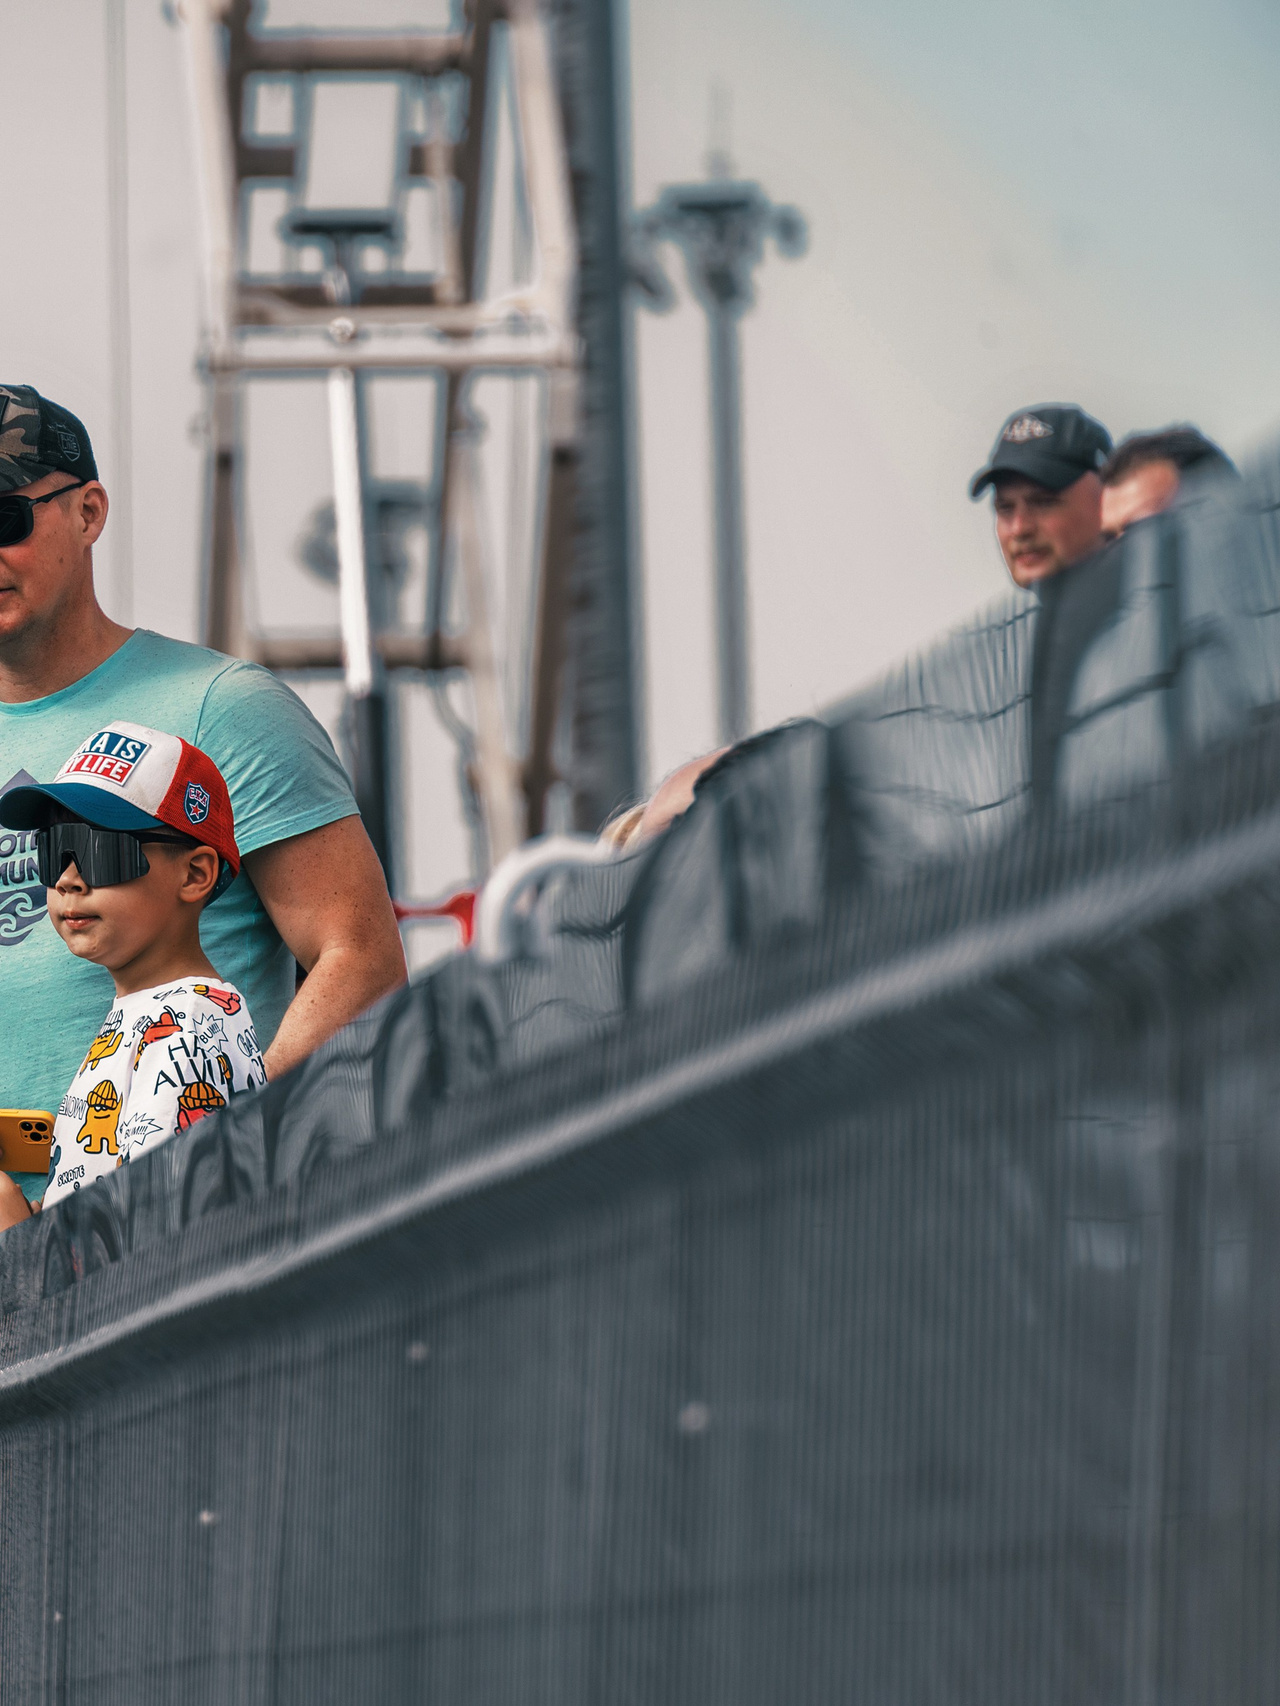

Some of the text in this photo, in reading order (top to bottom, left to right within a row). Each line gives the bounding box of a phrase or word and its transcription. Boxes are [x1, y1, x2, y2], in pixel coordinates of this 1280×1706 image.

[79, 732, 142, 760] KA IS
[80, 754, 129, 781] LIFE
[57, 1164, 86, 1187] SKATE
